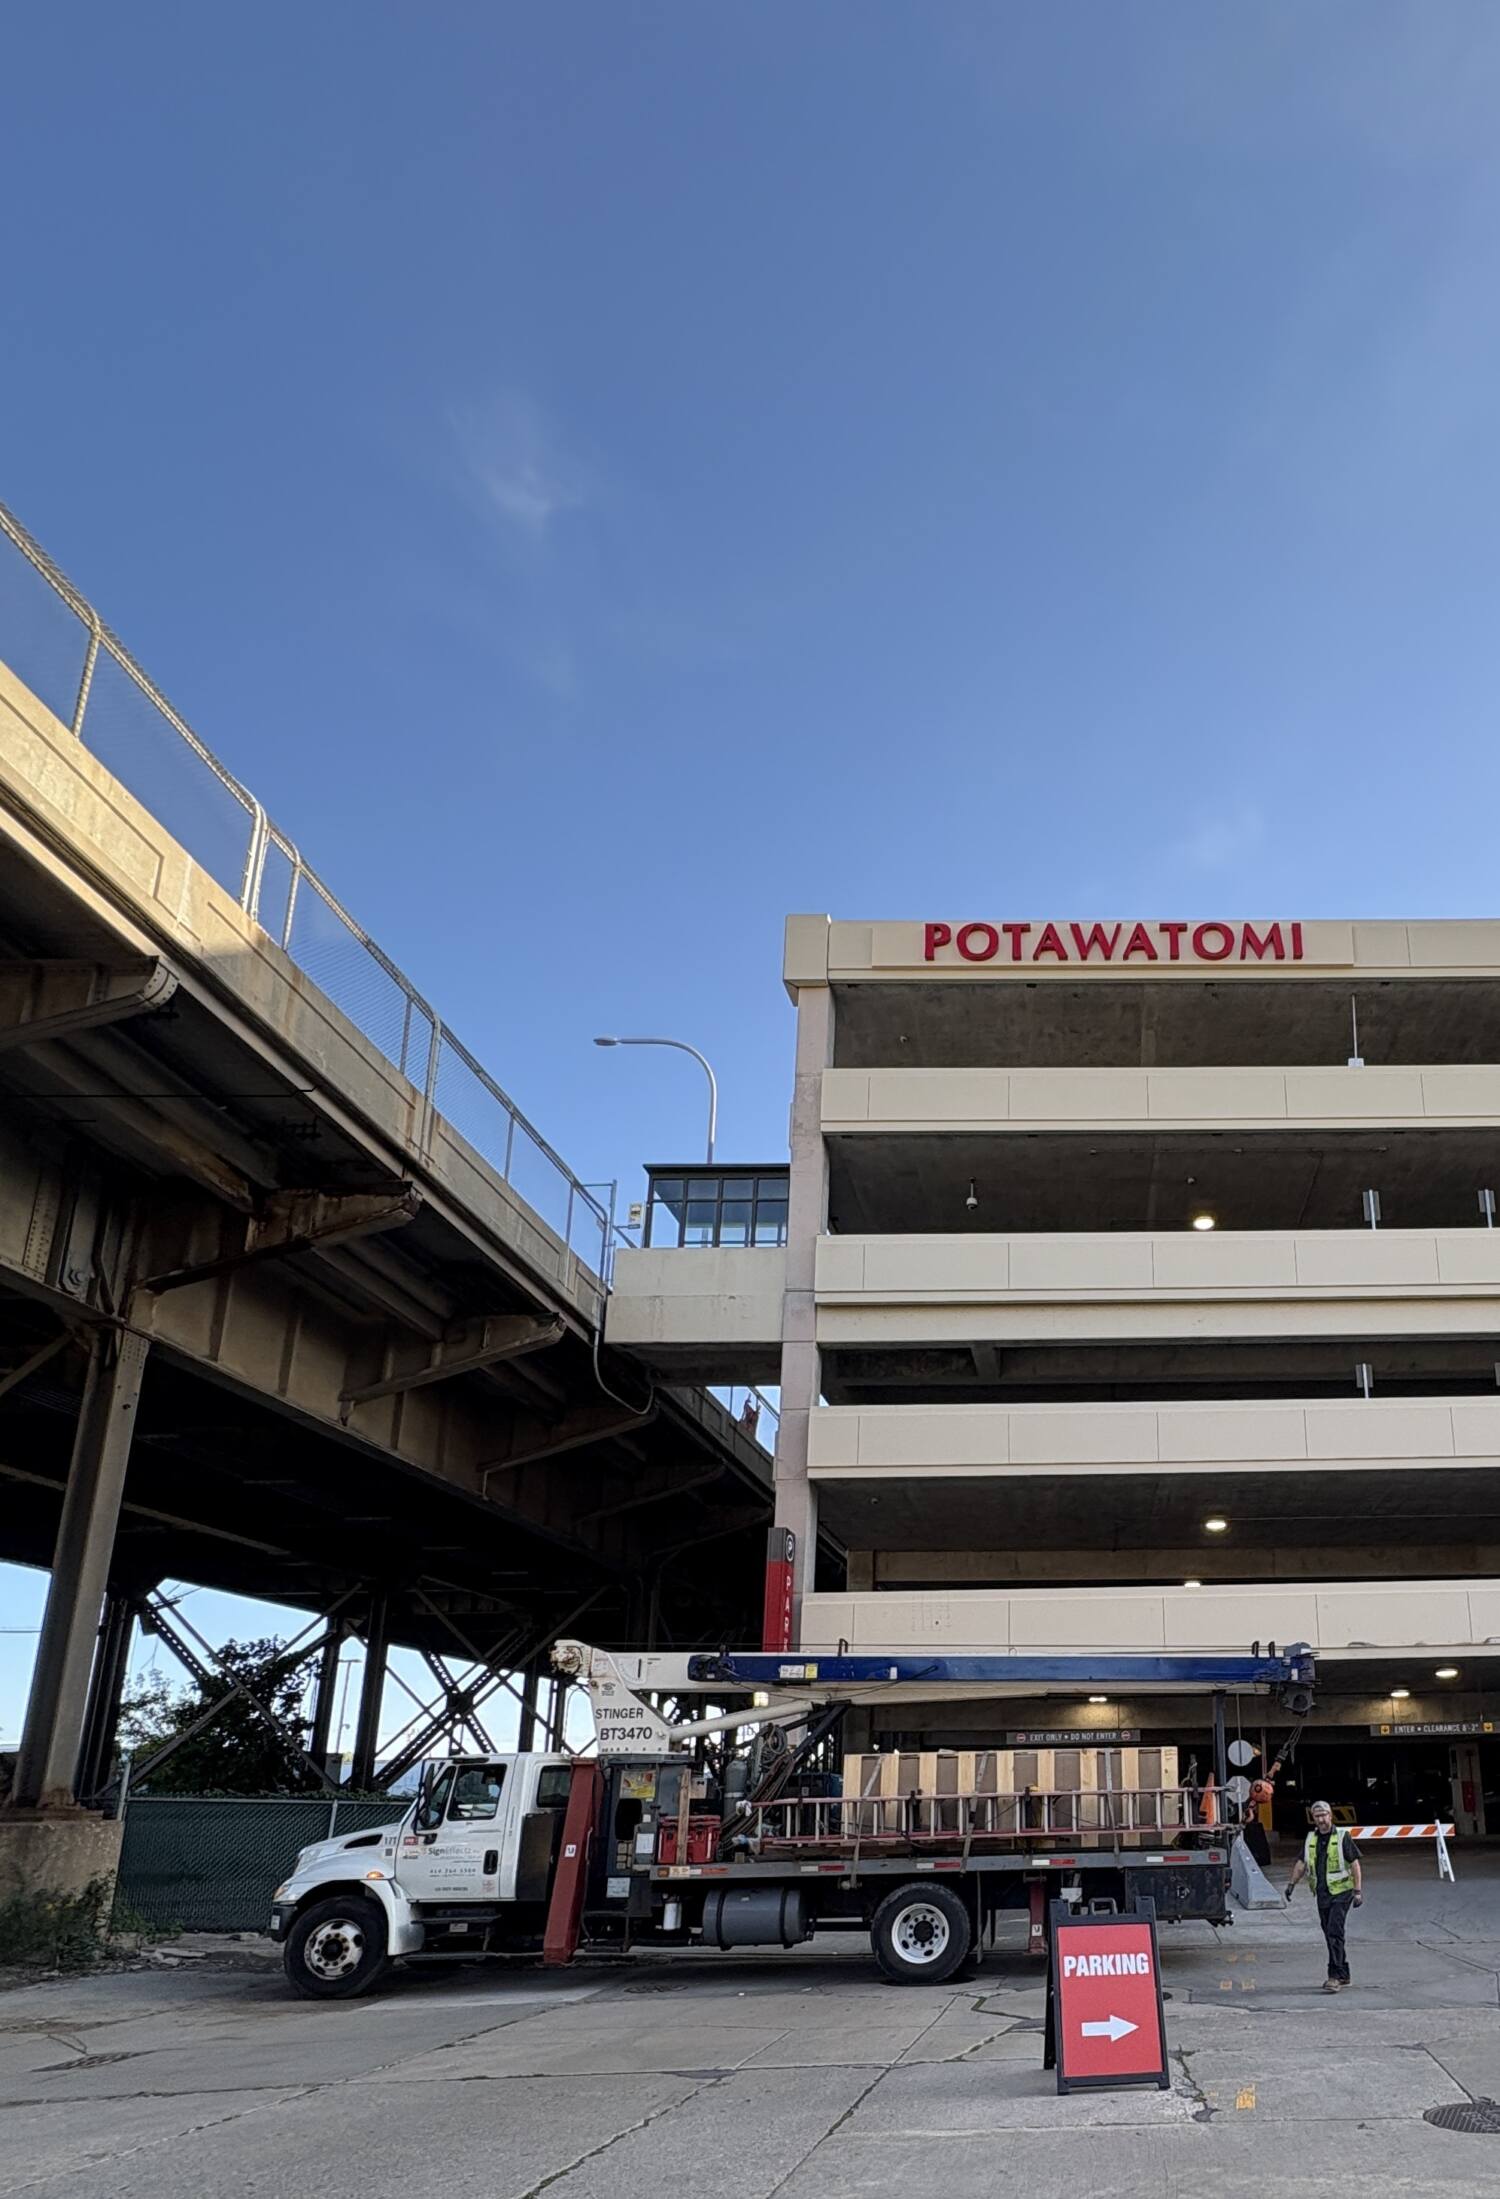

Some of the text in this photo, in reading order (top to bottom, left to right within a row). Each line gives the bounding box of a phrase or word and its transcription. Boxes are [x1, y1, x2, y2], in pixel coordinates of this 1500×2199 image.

[924, 922, 1303, 962] POTAWATOMI
[595, 1707, 644, 1719] STINGER
[600, 1726, 653, 1741] BT3470
[1394, 1725, 1415, 1734] ENTER
[1423, 1723, 1460, 1733] CLEARANCE
[1029, 1731, 1117, 1742] EXIT ONLY DO NOT ENTER
[1063, 1952, 1150, 1978] PARKING
